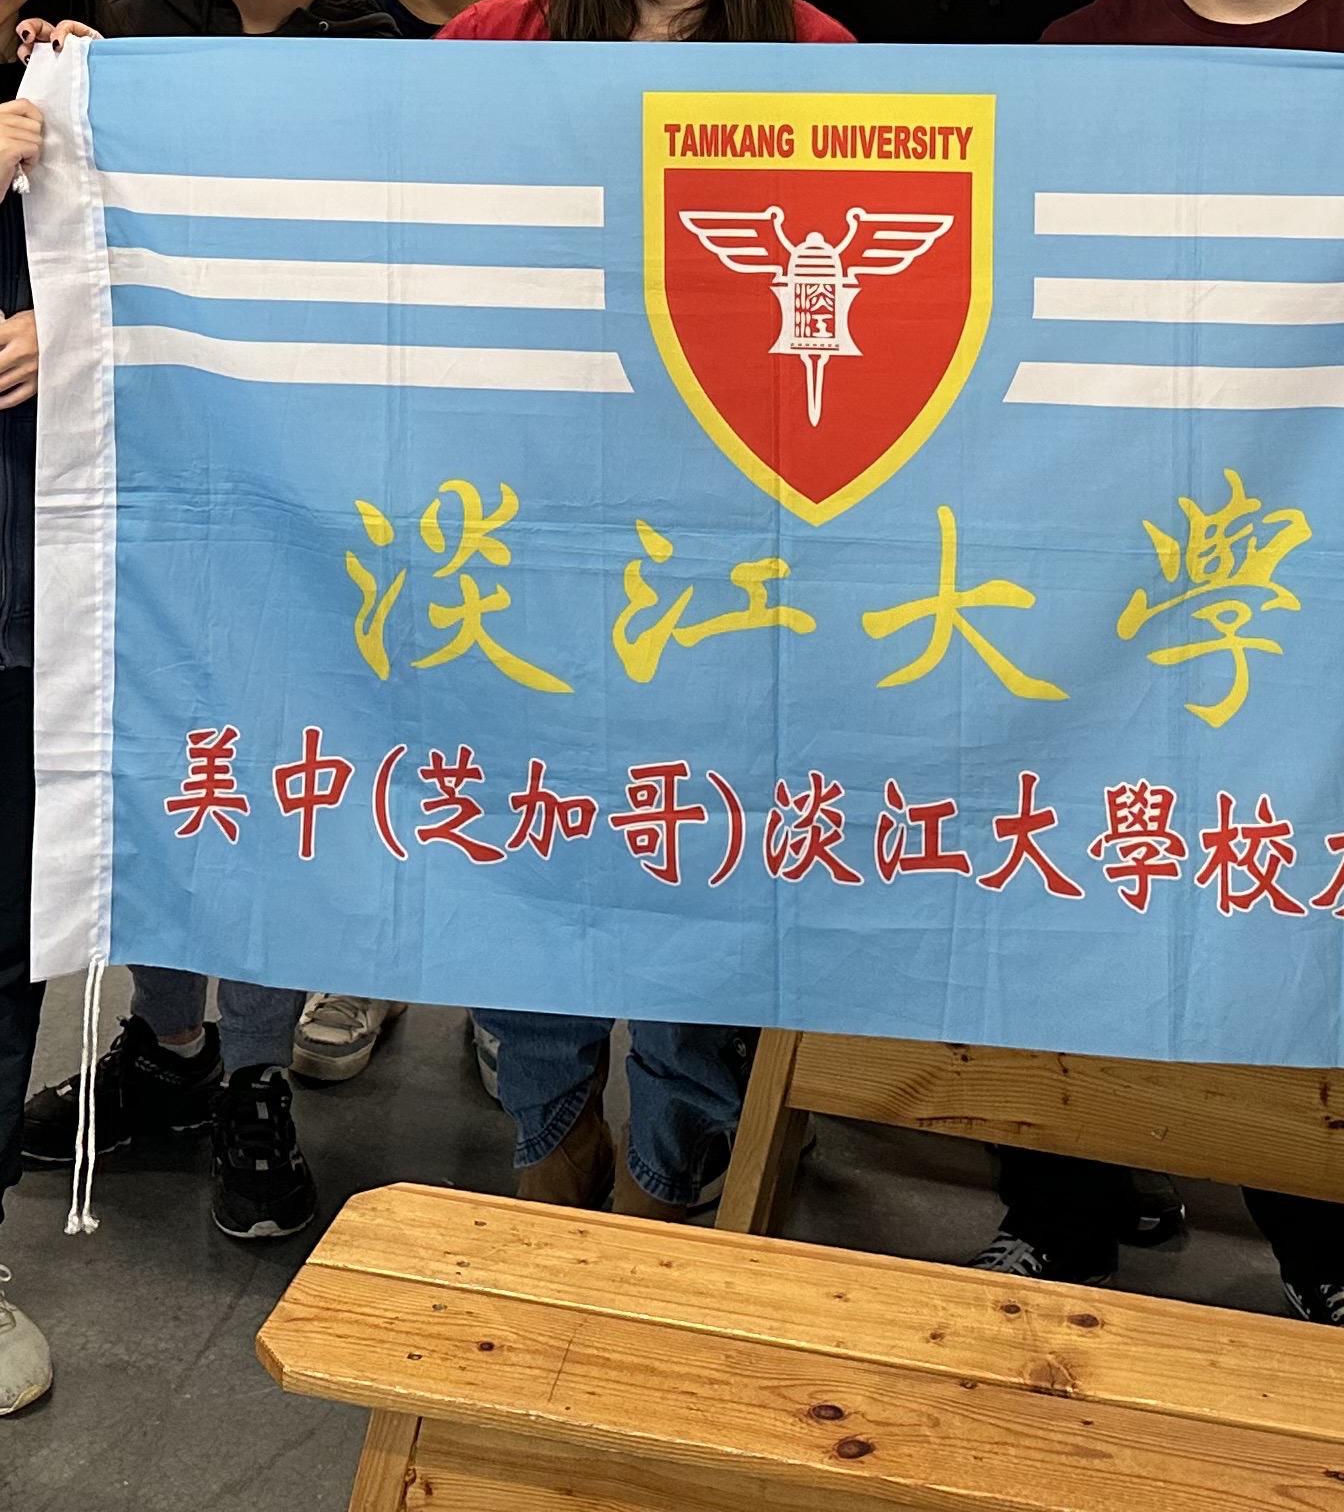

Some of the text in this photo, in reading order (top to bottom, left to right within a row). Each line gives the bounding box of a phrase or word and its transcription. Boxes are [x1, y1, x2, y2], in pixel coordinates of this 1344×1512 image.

[664, 124, 973, 160] TAMKANG UNIVERSITY
[346, 469, 1312, 729] 淡江大學
